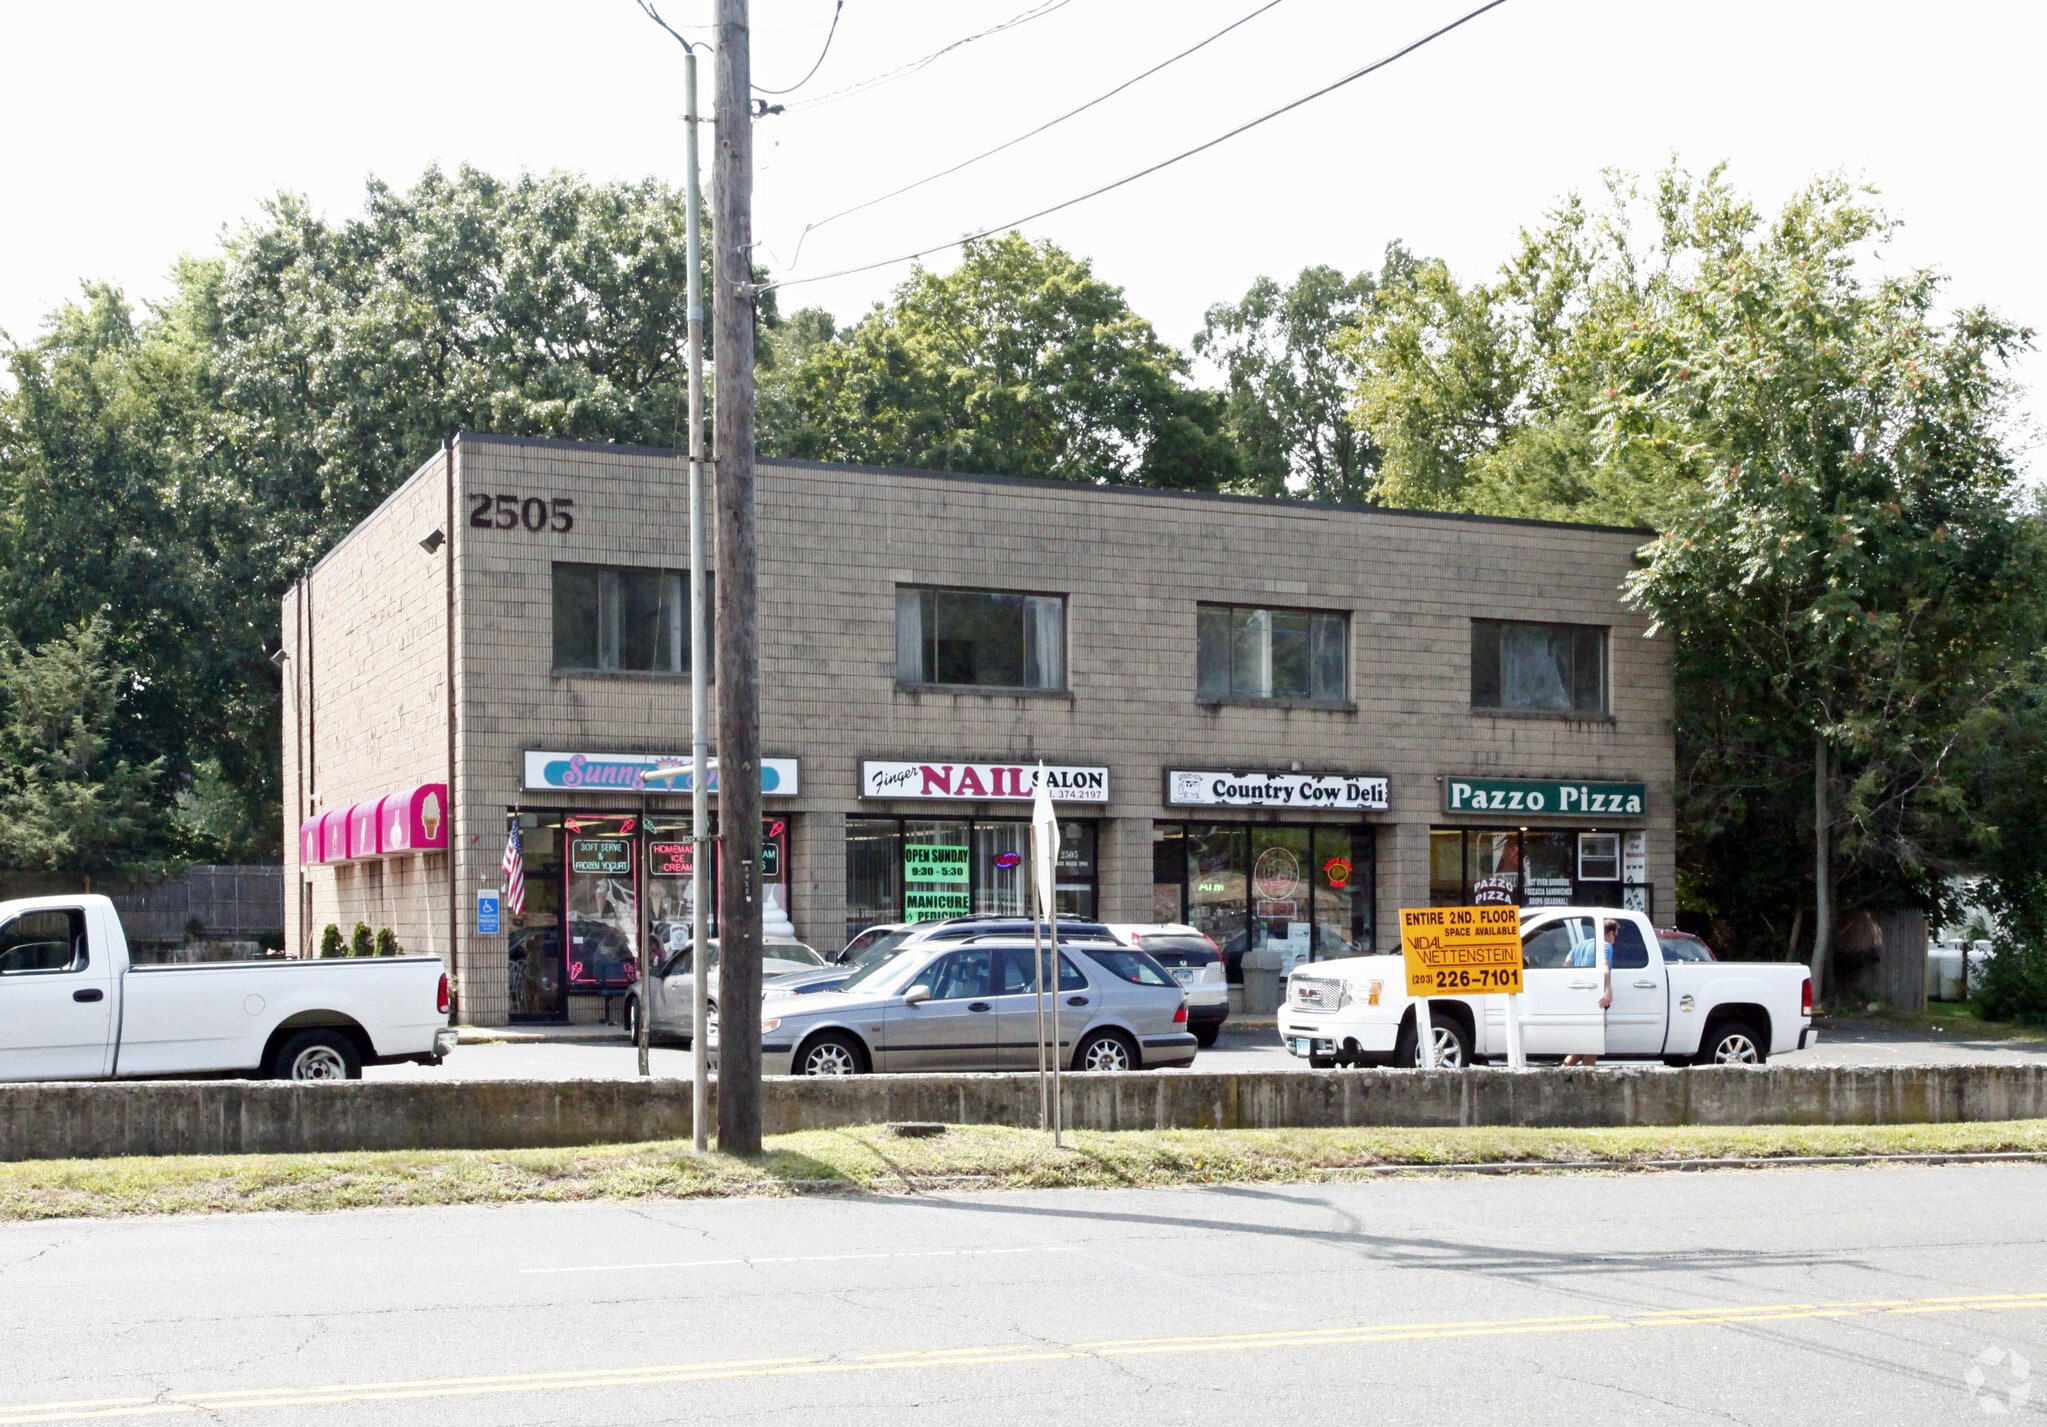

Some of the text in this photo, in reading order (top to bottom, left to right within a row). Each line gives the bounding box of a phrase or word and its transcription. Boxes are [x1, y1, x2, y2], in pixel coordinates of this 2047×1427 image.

[469, 493, 574, 533] 2505
[562, 754, 648, 791] Sunny
[872, 766, 1103, 797] Finger NAIL SALON
[1212, 779, 1383, 803] Country Cow Deli
[1451, 782, 1642, 813] Pazzo Pizza
[580, 843, 622, 852] SOFT SERVE
[654, 844, 694, 854] HOMEMAD
[670, 854, 685, 864] ICE
[905, 848, 969, 864] OPEN SUNDAY
[575, 861, 600, 870] FROZEN
[663, 863, 694, 872] CREAM
[912, 867, 934, 876] 9:30
[941, 867, 963, 876] 5:30
[1474, 878, 1514, 893] PAZZO
[906, 895, 969, 909] MANICURE
[1475, 890, 1512, 905] PIZZA
[1406, 910, 1516, 926] ENTIRE 2ND. FLOOR
[1444, 926, 1517, 937] SPACE AVAILABLE
[1407, 936, 1444, 950] VIDAL
[1417, 948, 1514, 963] WETTENSTEIN
[1412, 969, 1519, 988] (203) 226-7101
